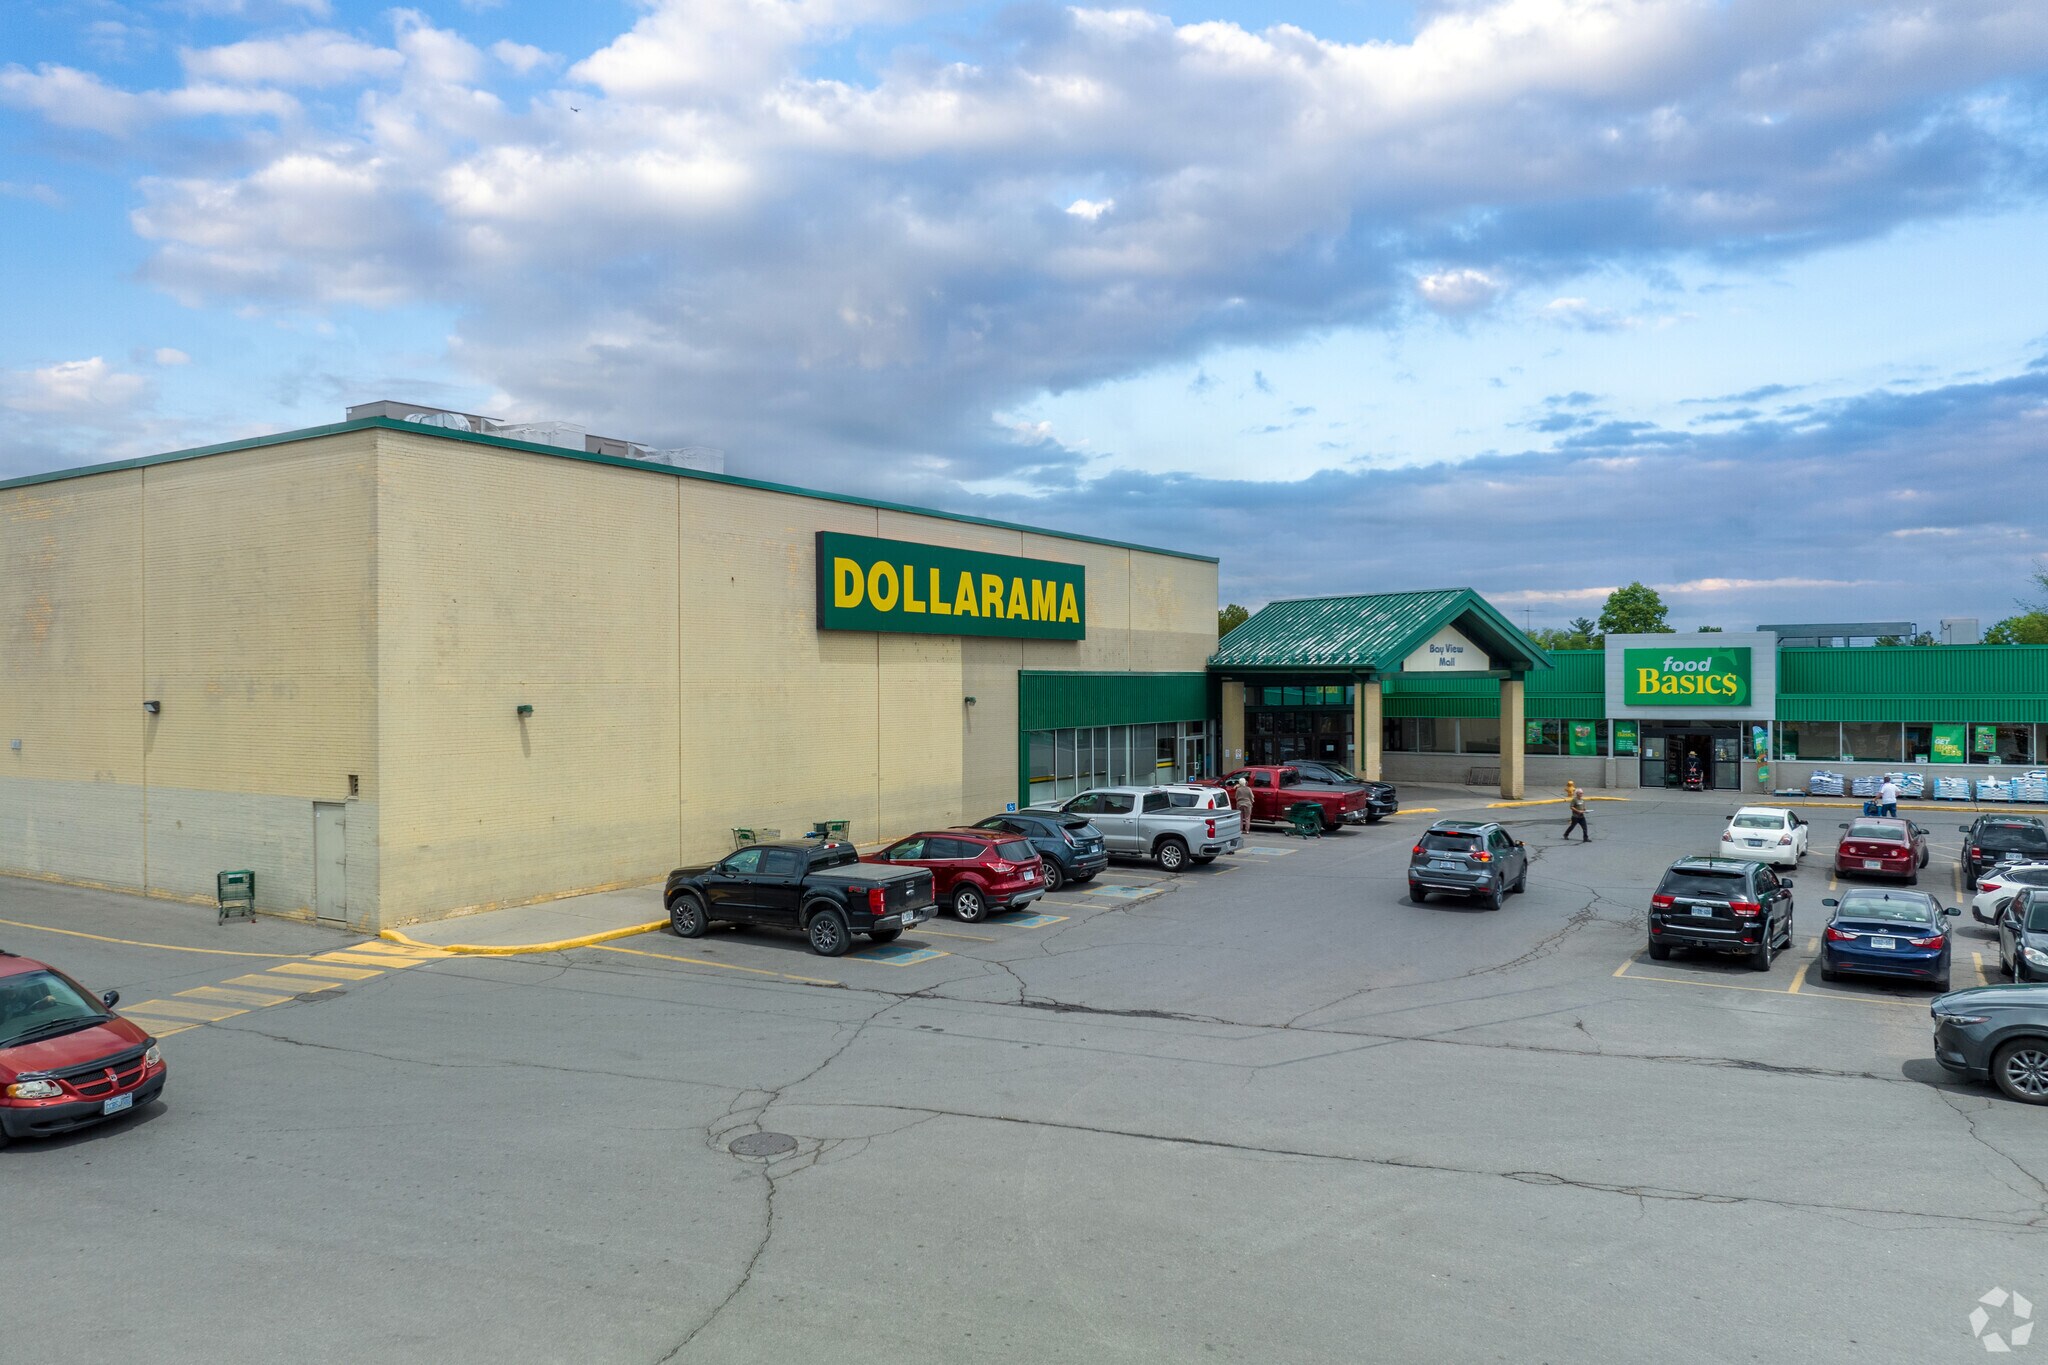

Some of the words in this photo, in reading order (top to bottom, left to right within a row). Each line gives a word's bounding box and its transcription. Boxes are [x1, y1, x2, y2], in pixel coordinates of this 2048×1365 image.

[833, 556, 1080, 624] DOLLARAMA
[1429, 644, 1444, 655] Bay
[1445, 644, 1464, 653] View
[1439, 657, 1455, 667] Mall
[1663, 656, 1712, 672] food
